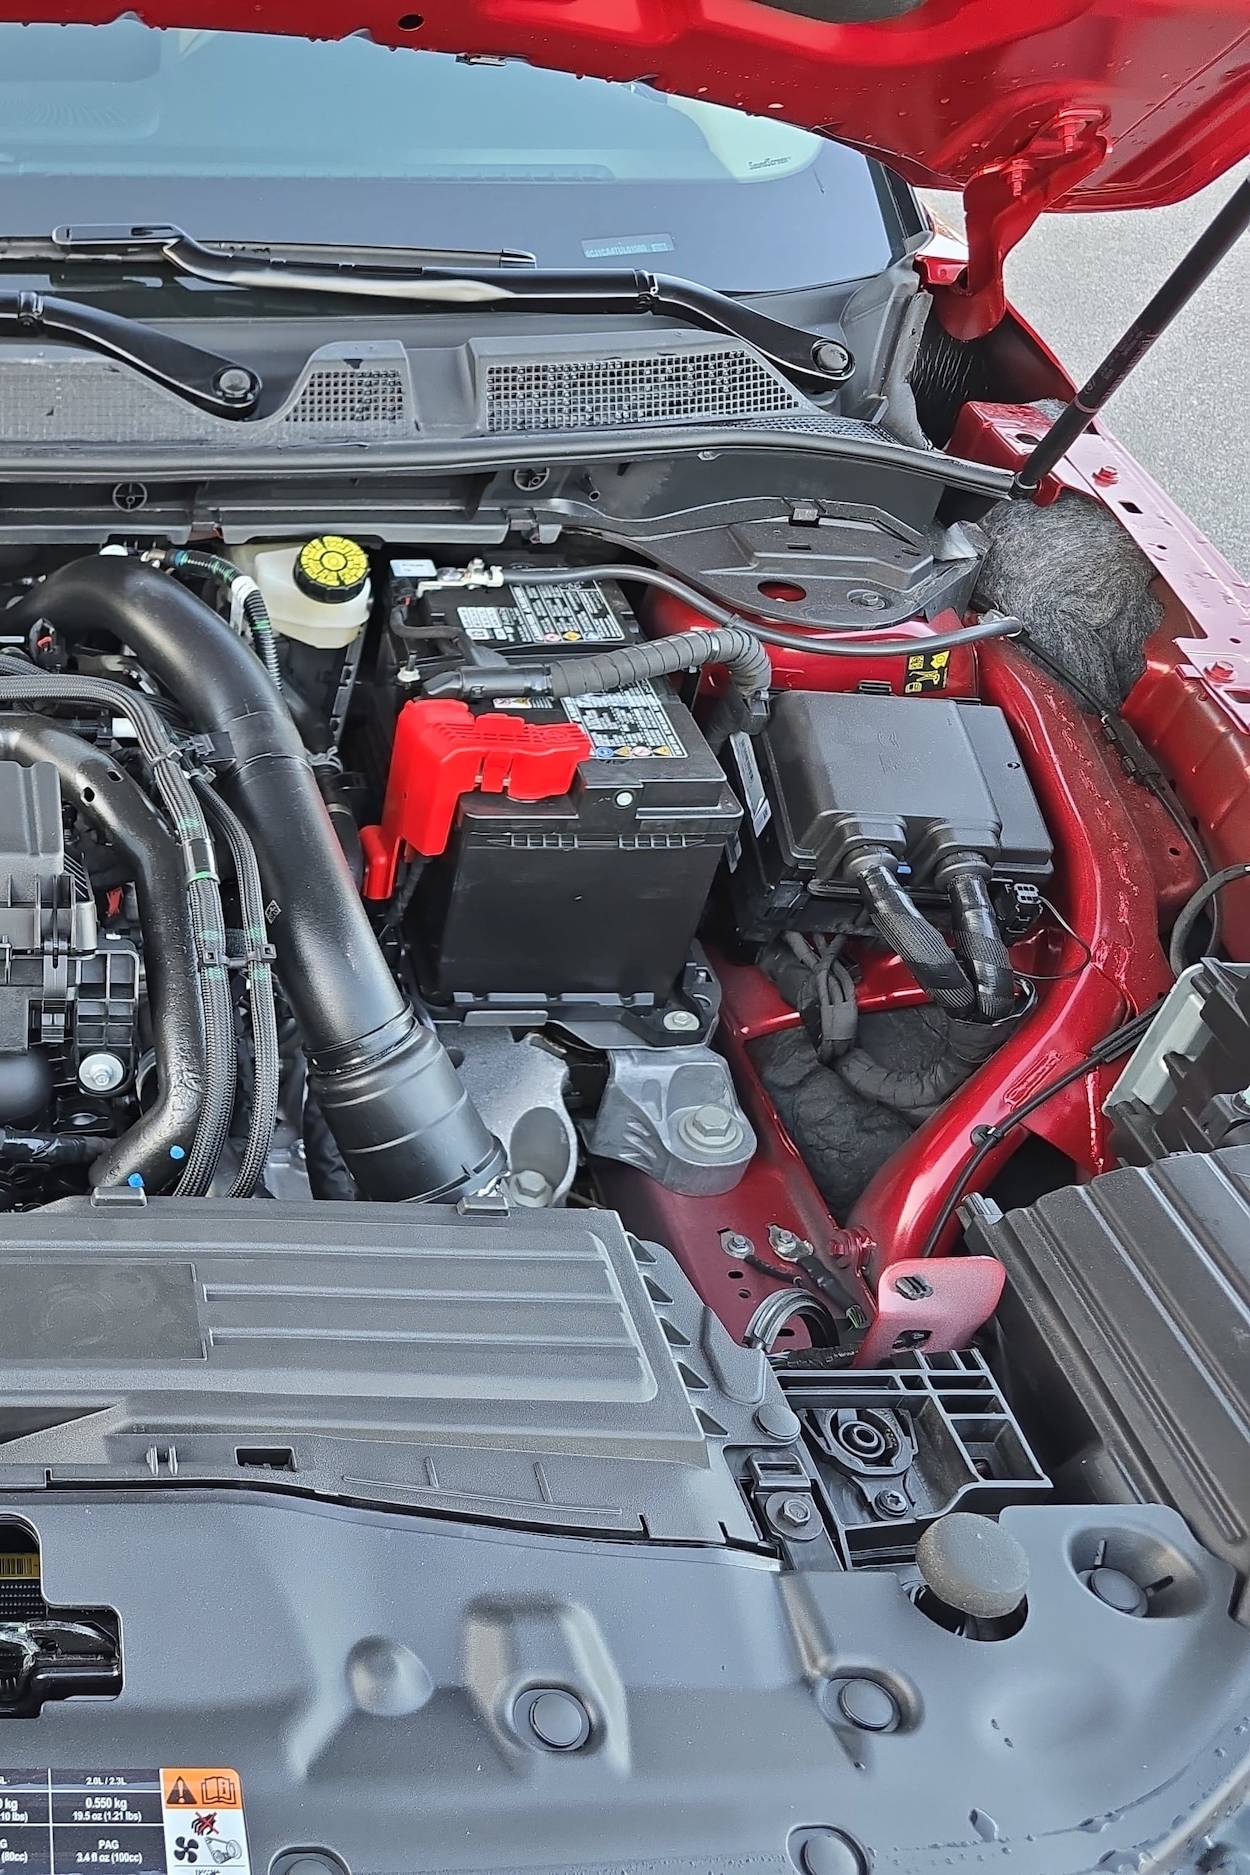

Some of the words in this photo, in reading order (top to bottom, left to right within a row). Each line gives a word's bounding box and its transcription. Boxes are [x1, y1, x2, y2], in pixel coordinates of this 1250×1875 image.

[85, 1777, 104, 1785] 2.0L
[109, 1777, 127, 1785] 2.3L
[4, 1798, 18, 1811] kg
[85, 1797, 112, 1809] 0.550
[114, 1797, 128, 1811] kg
[11, 1812, 29, 1823] lbs)
[72, 1811, 90, 1821] 19.5
[91, 1813, 103, 1821] oz
[104, 1811, 125, 1822] (1.21
[125, 1811, 142, 1822] lbs)
[98, 1840, 120, 1850] PAG
[1, 1851, 28, 1864] (80cc)
[76, 1852, 90, 1863] 3.4
[99, 1855, 110, 1863] oz
[111, 1852, 143, 1864] (100cc)
